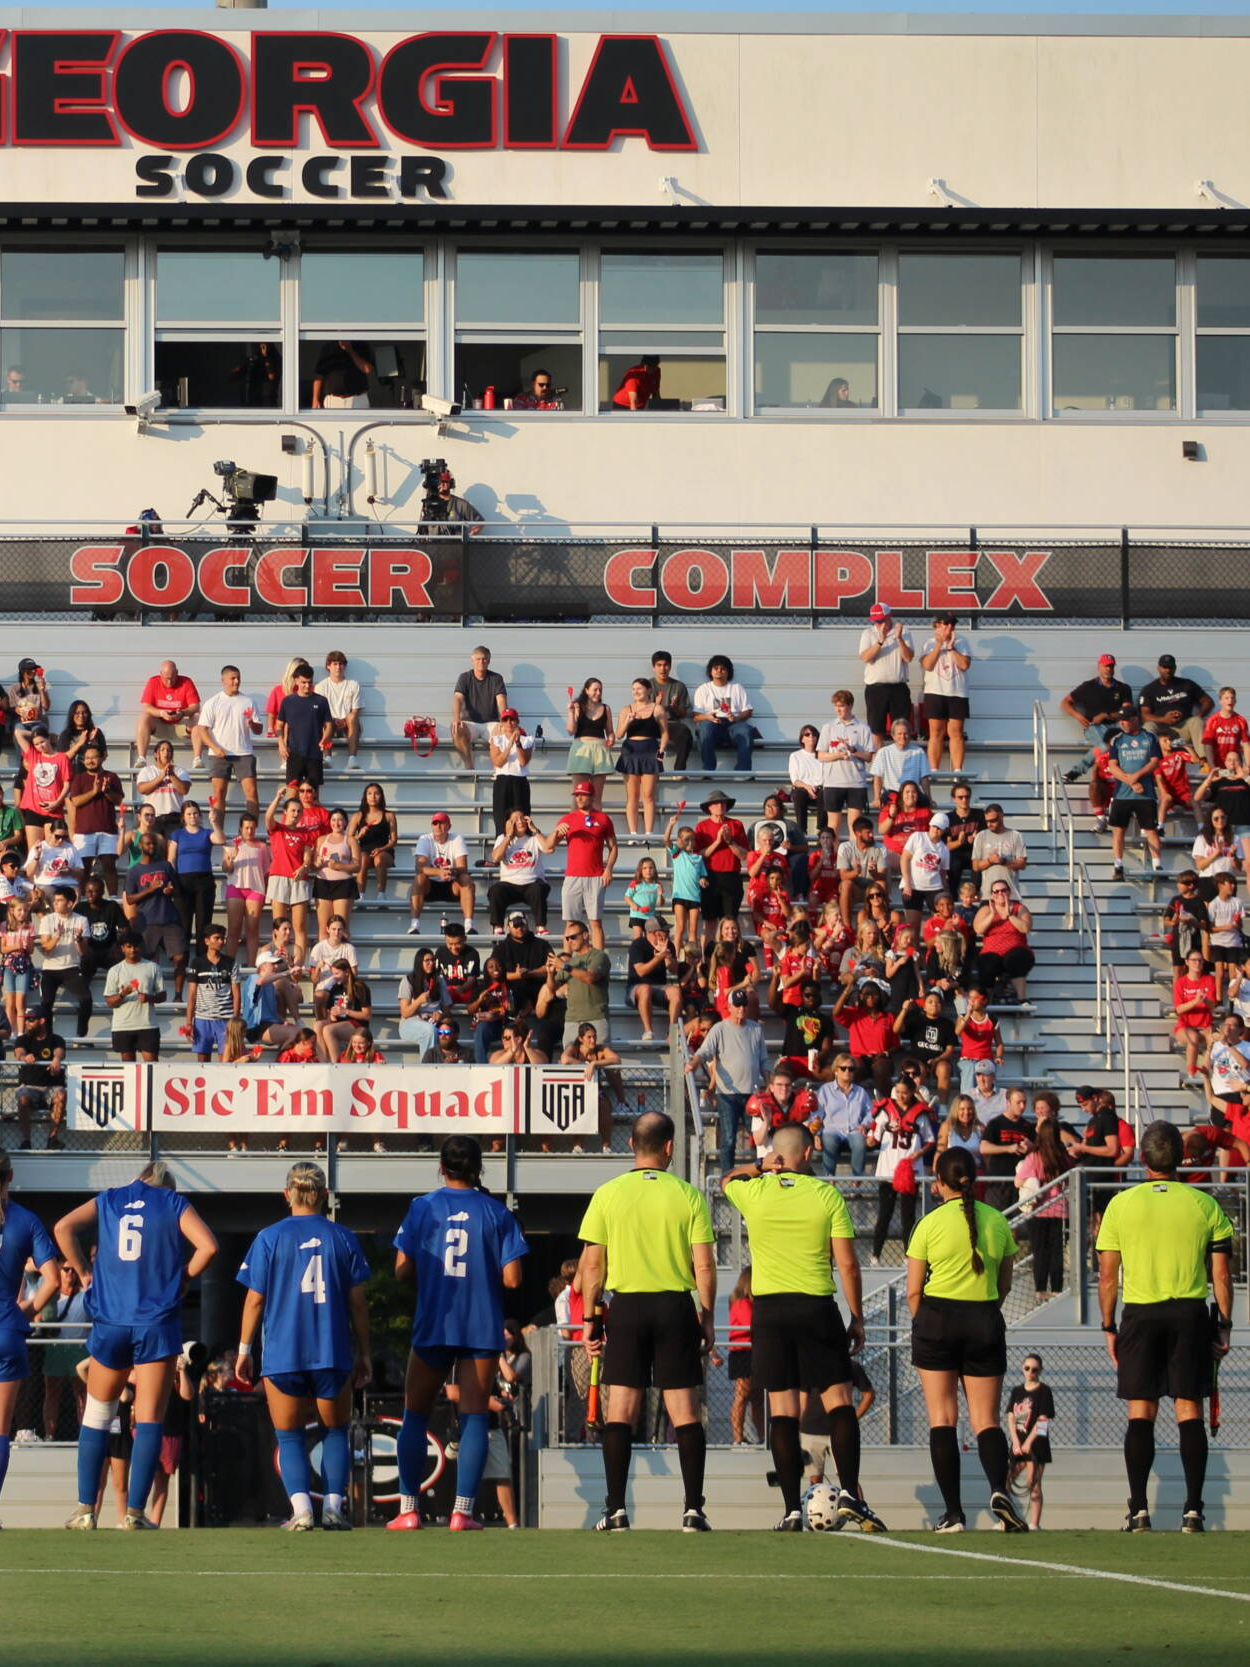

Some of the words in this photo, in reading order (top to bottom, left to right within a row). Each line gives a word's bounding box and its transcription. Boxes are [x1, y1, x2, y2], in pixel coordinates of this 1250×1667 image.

[135, 153, 447, 199] SOCCER
[70, 545, 434, 608] SOCCER
[604, 549, 1053, 610] COMPLEX
[81, 1080, 124, 1128] UGA
[350, 1077, 504, 1129] Squad
[542, 1083, 585, 1131] UGA
[118, 1214, 143, 1262] 6
[444, 1228, 469, 1278] 2
[301, 1255, 327, 1304] 4
